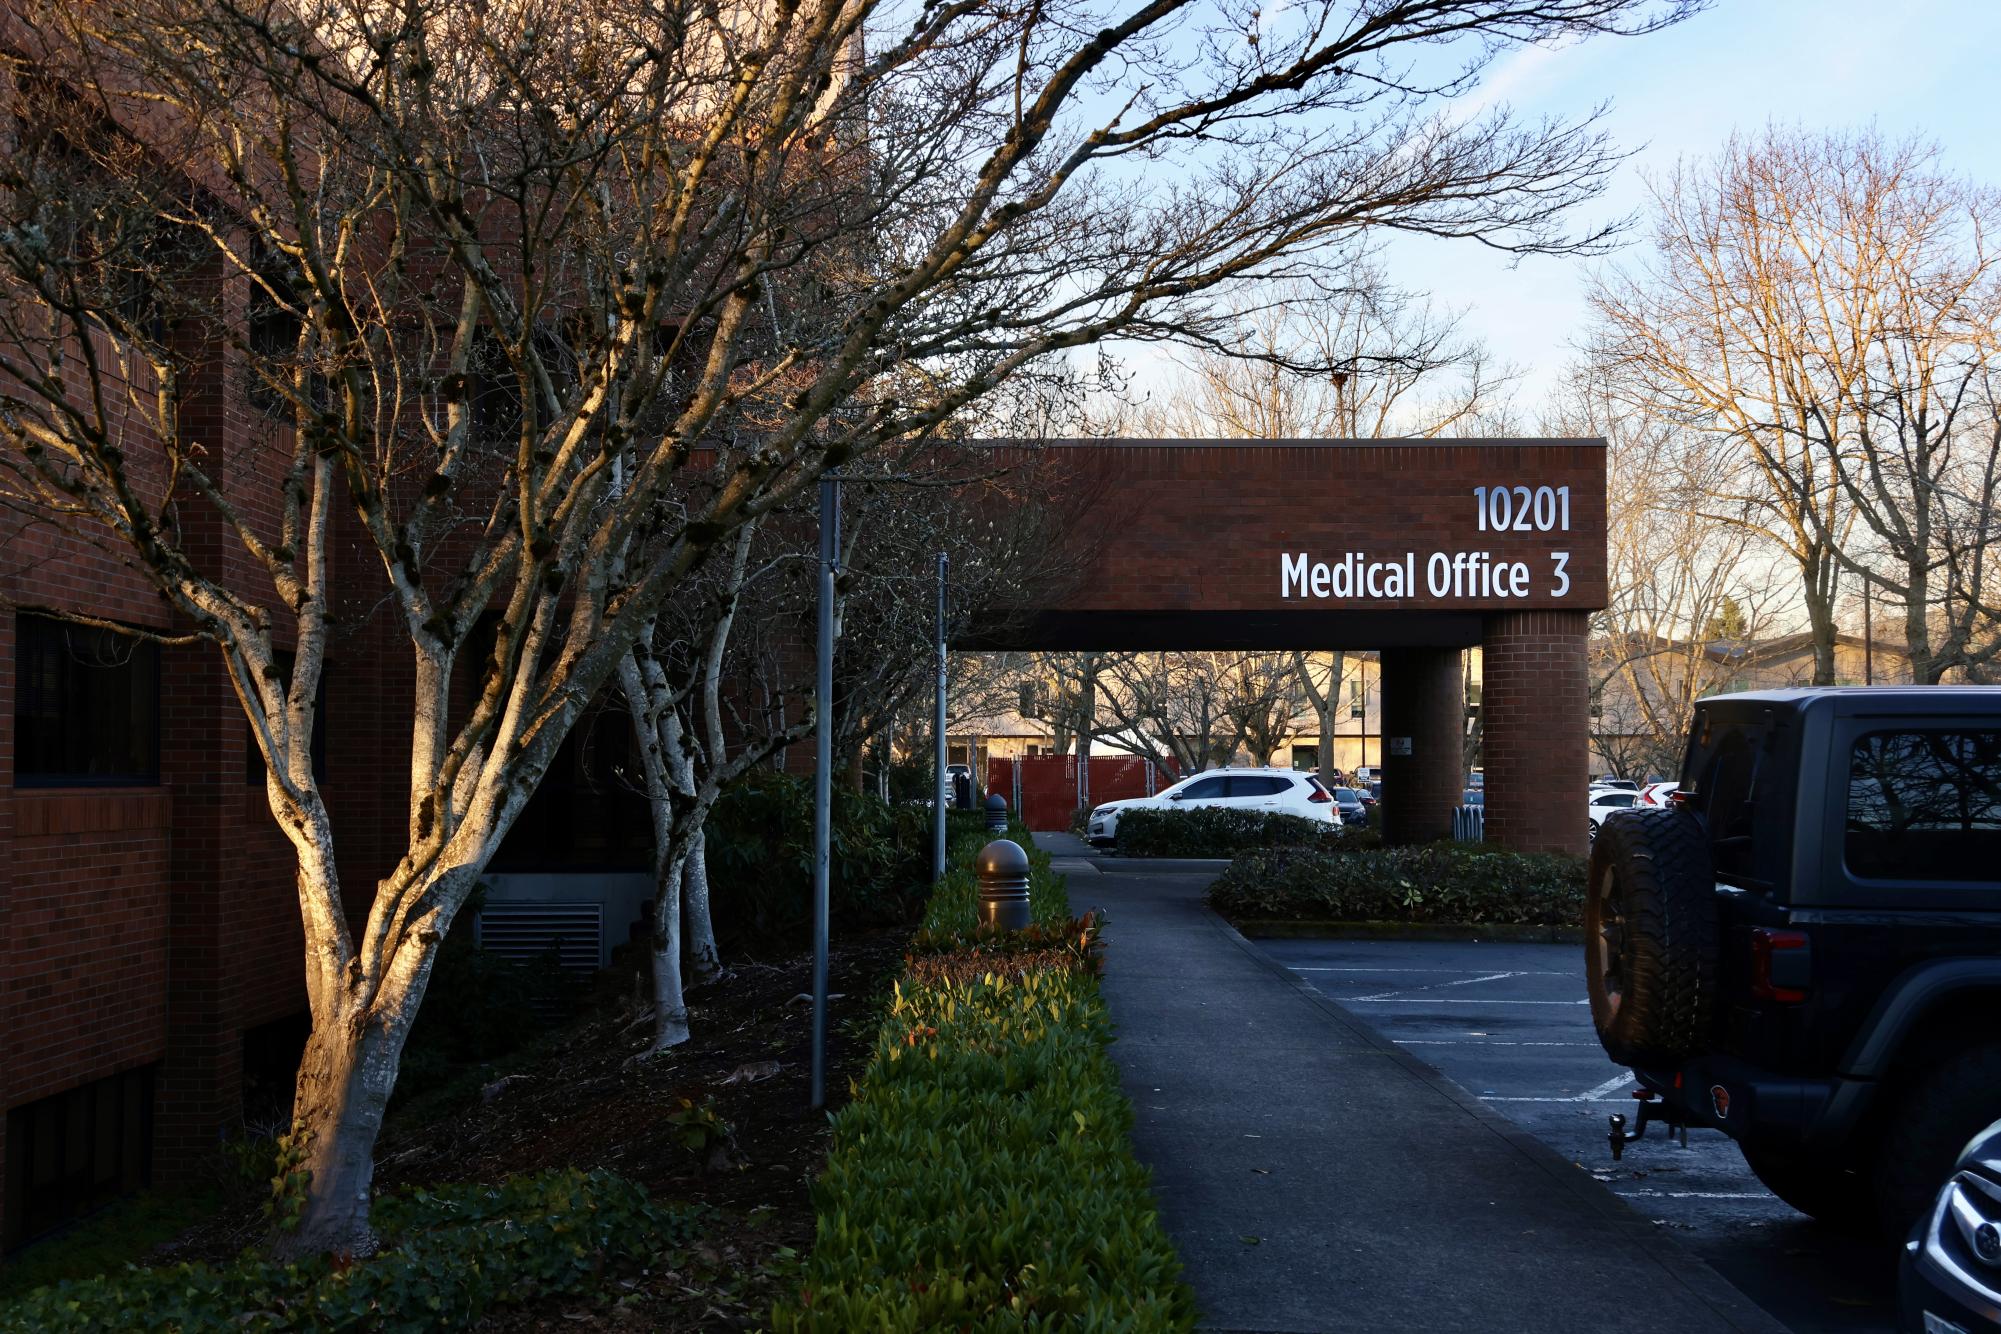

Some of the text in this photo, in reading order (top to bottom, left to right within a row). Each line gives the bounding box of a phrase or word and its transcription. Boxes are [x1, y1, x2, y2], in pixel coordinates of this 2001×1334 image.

[1474, 486, 1570, 532] 10201
[1281, 552, 1570, 598] Medical Office 3
